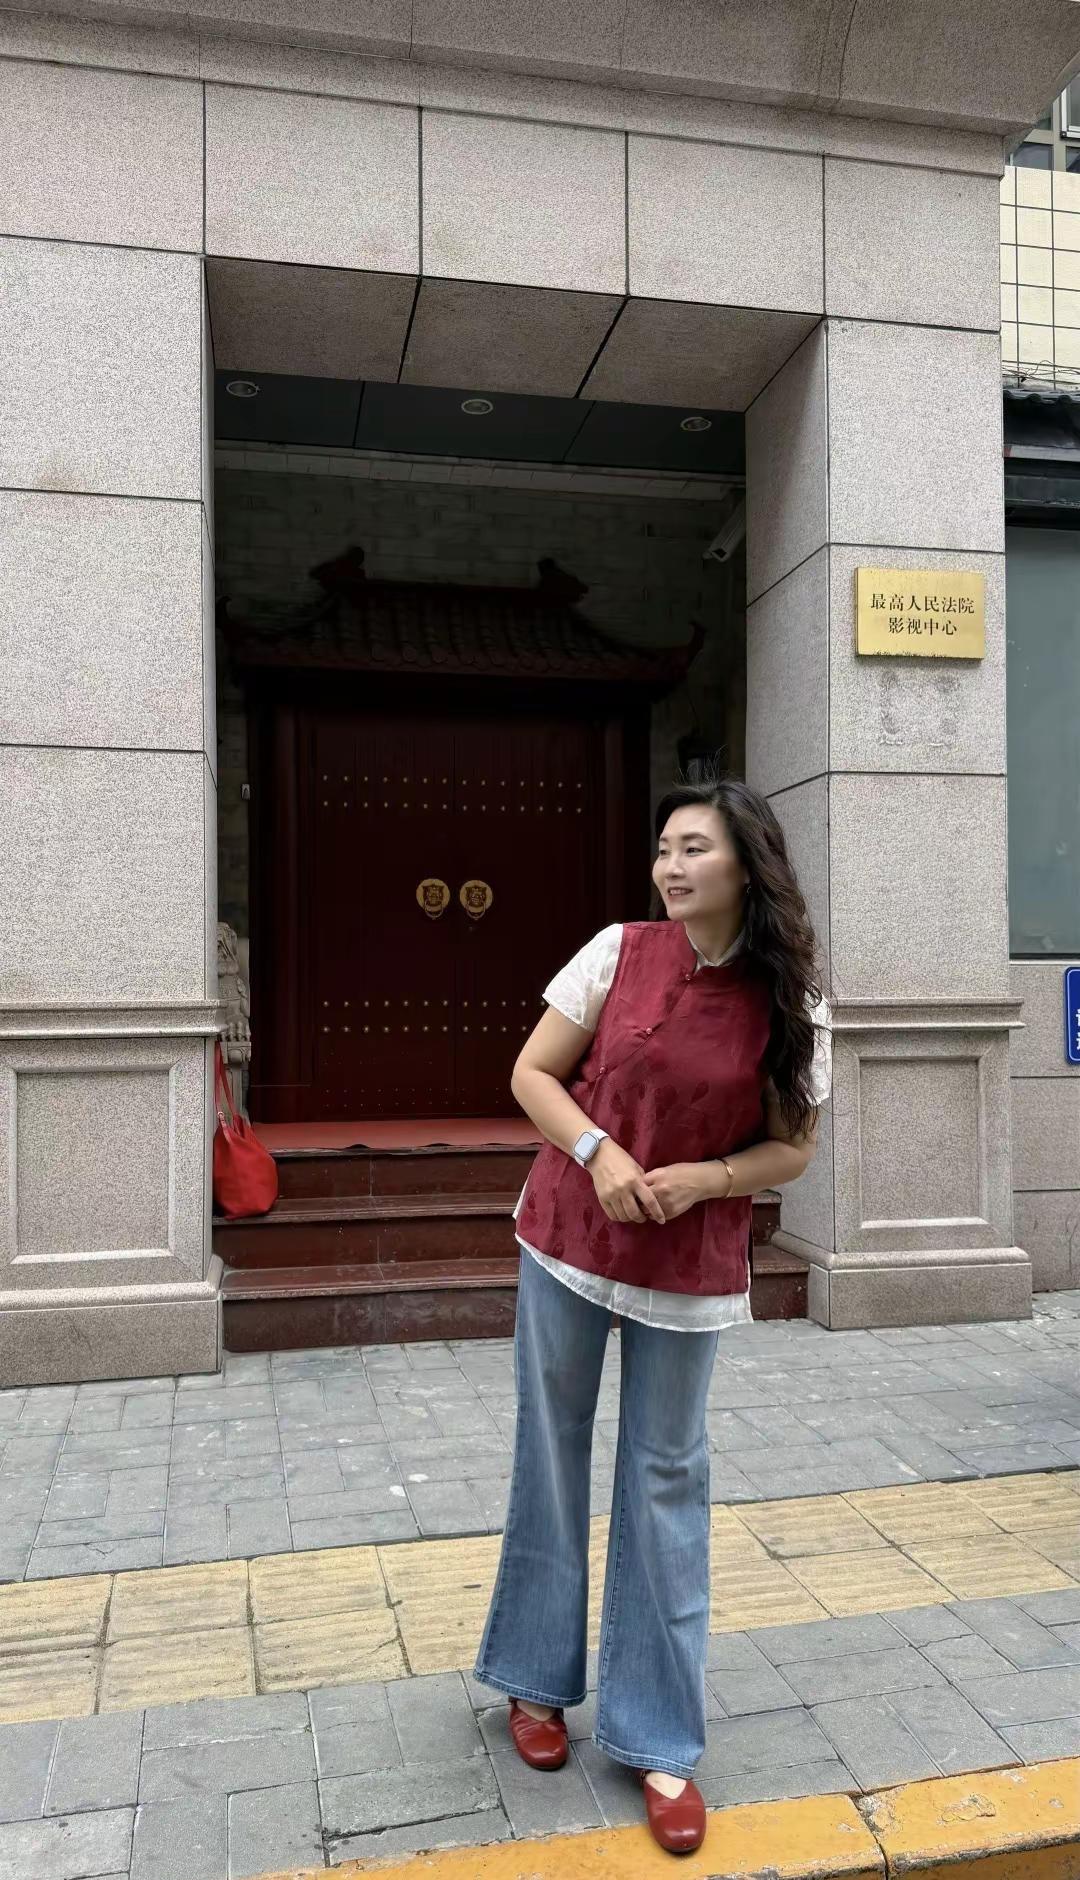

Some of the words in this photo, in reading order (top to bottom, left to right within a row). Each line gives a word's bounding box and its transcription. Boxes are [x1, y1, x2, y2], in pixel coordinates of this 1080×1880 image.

[870, 593, 975, 614] 最高人民法院
[888, 617, 957, 636] 影视中心
